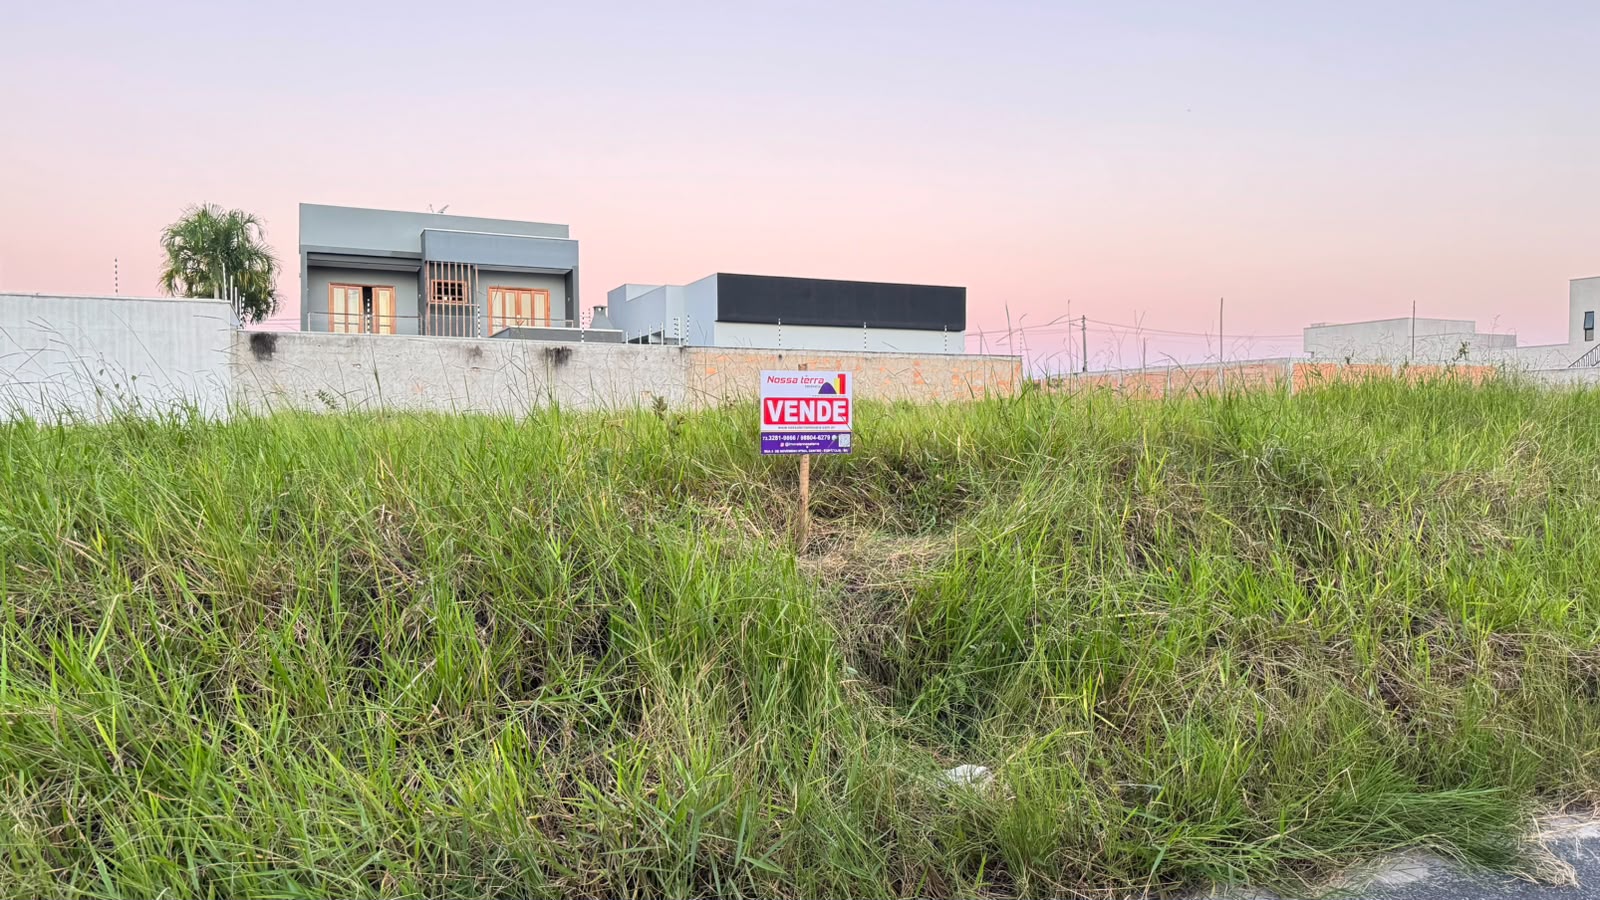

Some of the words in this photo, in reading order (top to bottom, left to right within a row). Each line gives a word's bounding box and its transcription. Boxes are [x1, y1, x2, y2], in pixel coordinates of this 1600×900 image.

[767, 375, 798, 384] Nossa
[800, 375, 825, 384] terra
[766, 399, 847, 422] VENDE
